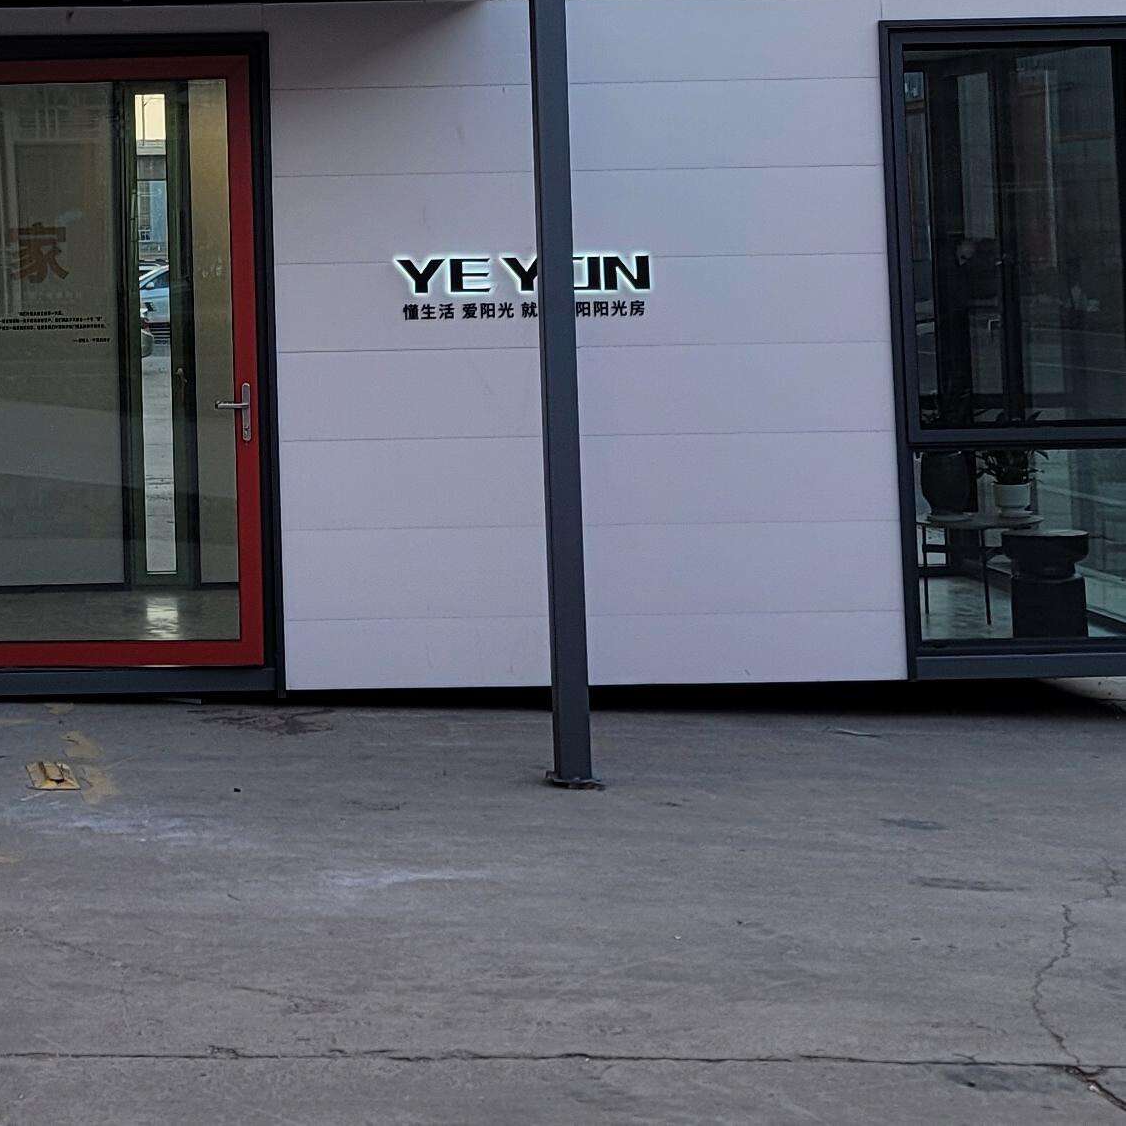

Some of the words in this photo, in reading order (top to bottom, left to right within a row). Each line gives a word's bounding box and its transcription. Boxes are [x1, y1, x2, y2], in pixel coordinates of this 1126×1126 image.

[10, 222, 69, 283] 家
[403, 303, 455, 320] 懂生活
[462, 302, 514, 319] 爱阳光
